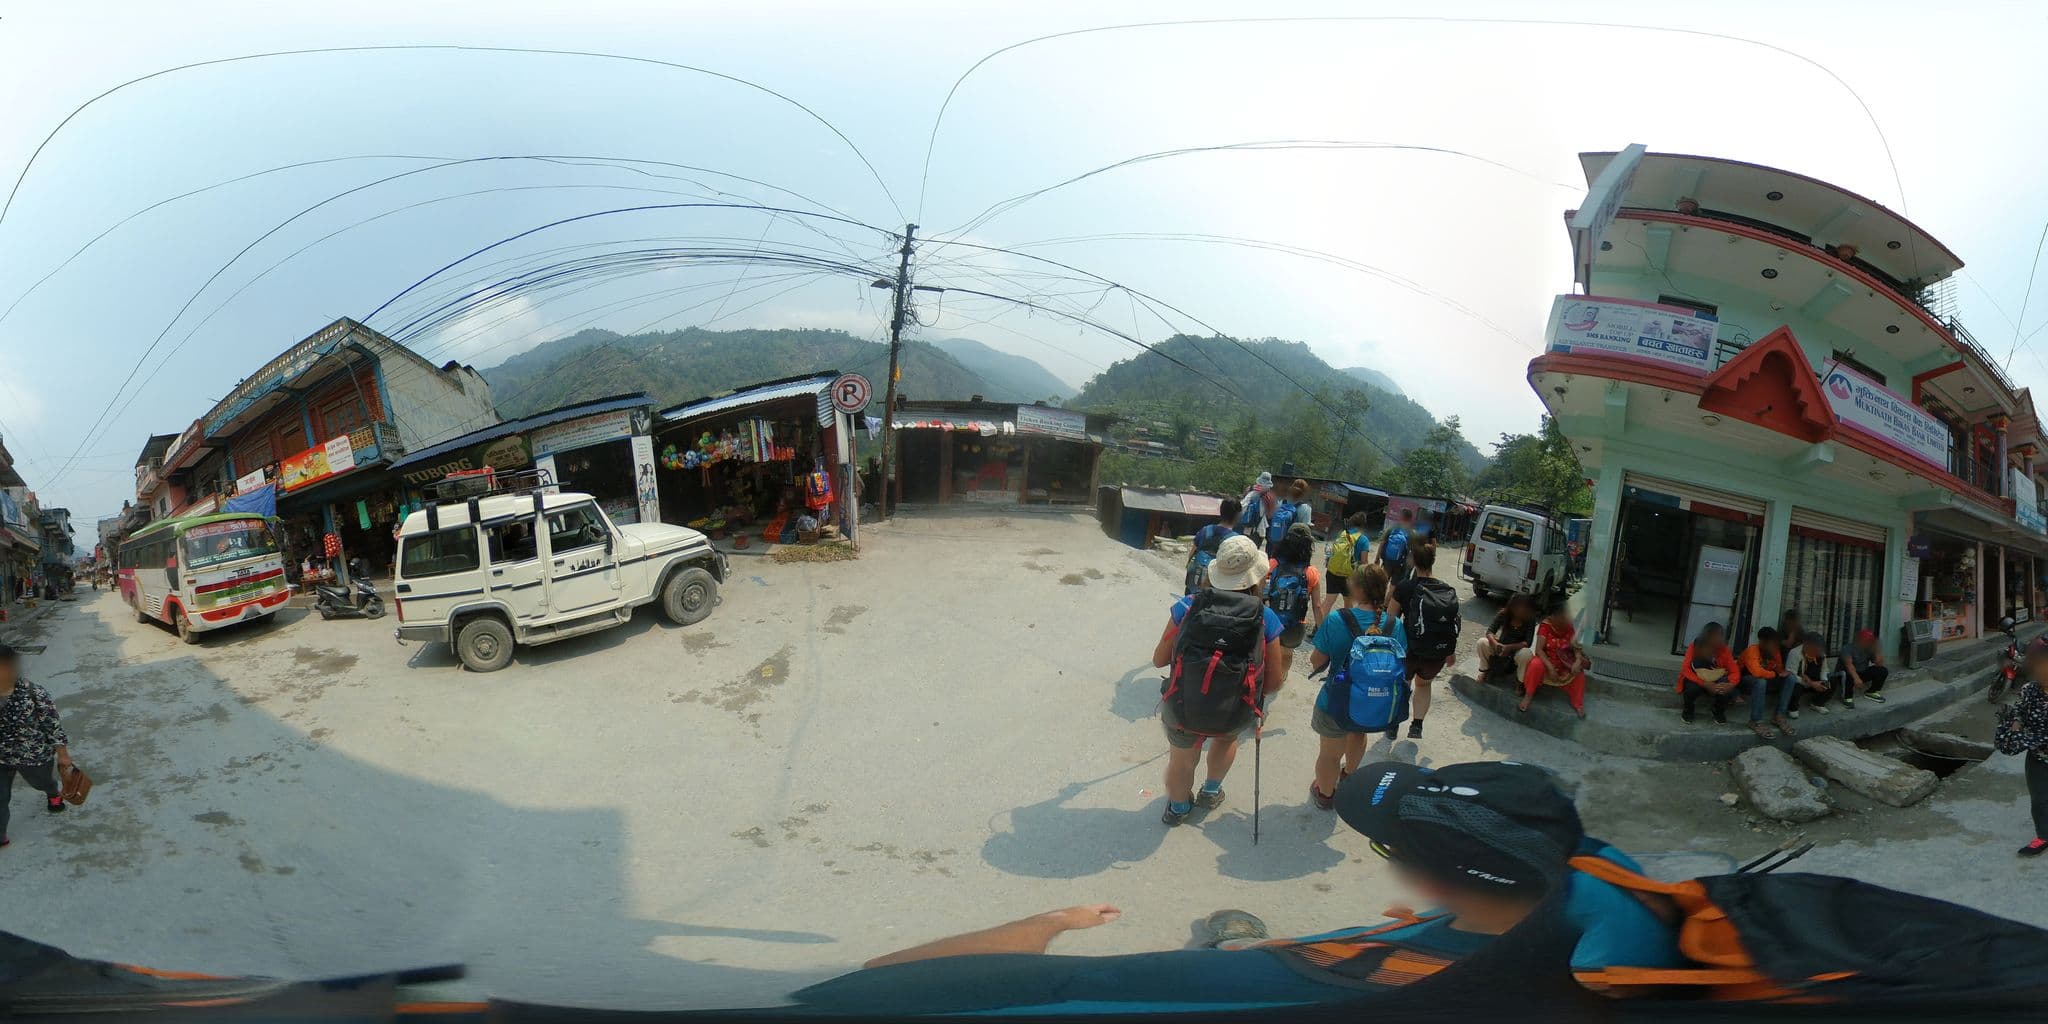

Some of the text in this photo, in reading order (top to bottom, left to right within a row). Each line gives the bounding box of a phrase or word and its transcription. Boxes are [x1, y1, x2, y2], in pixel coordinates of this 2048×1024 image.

[1599, 333, 1631, 343] BANKING
[1855, 397, 1892, 424] MUKTINATH
[403, 457, 473, 485] TUBORG
